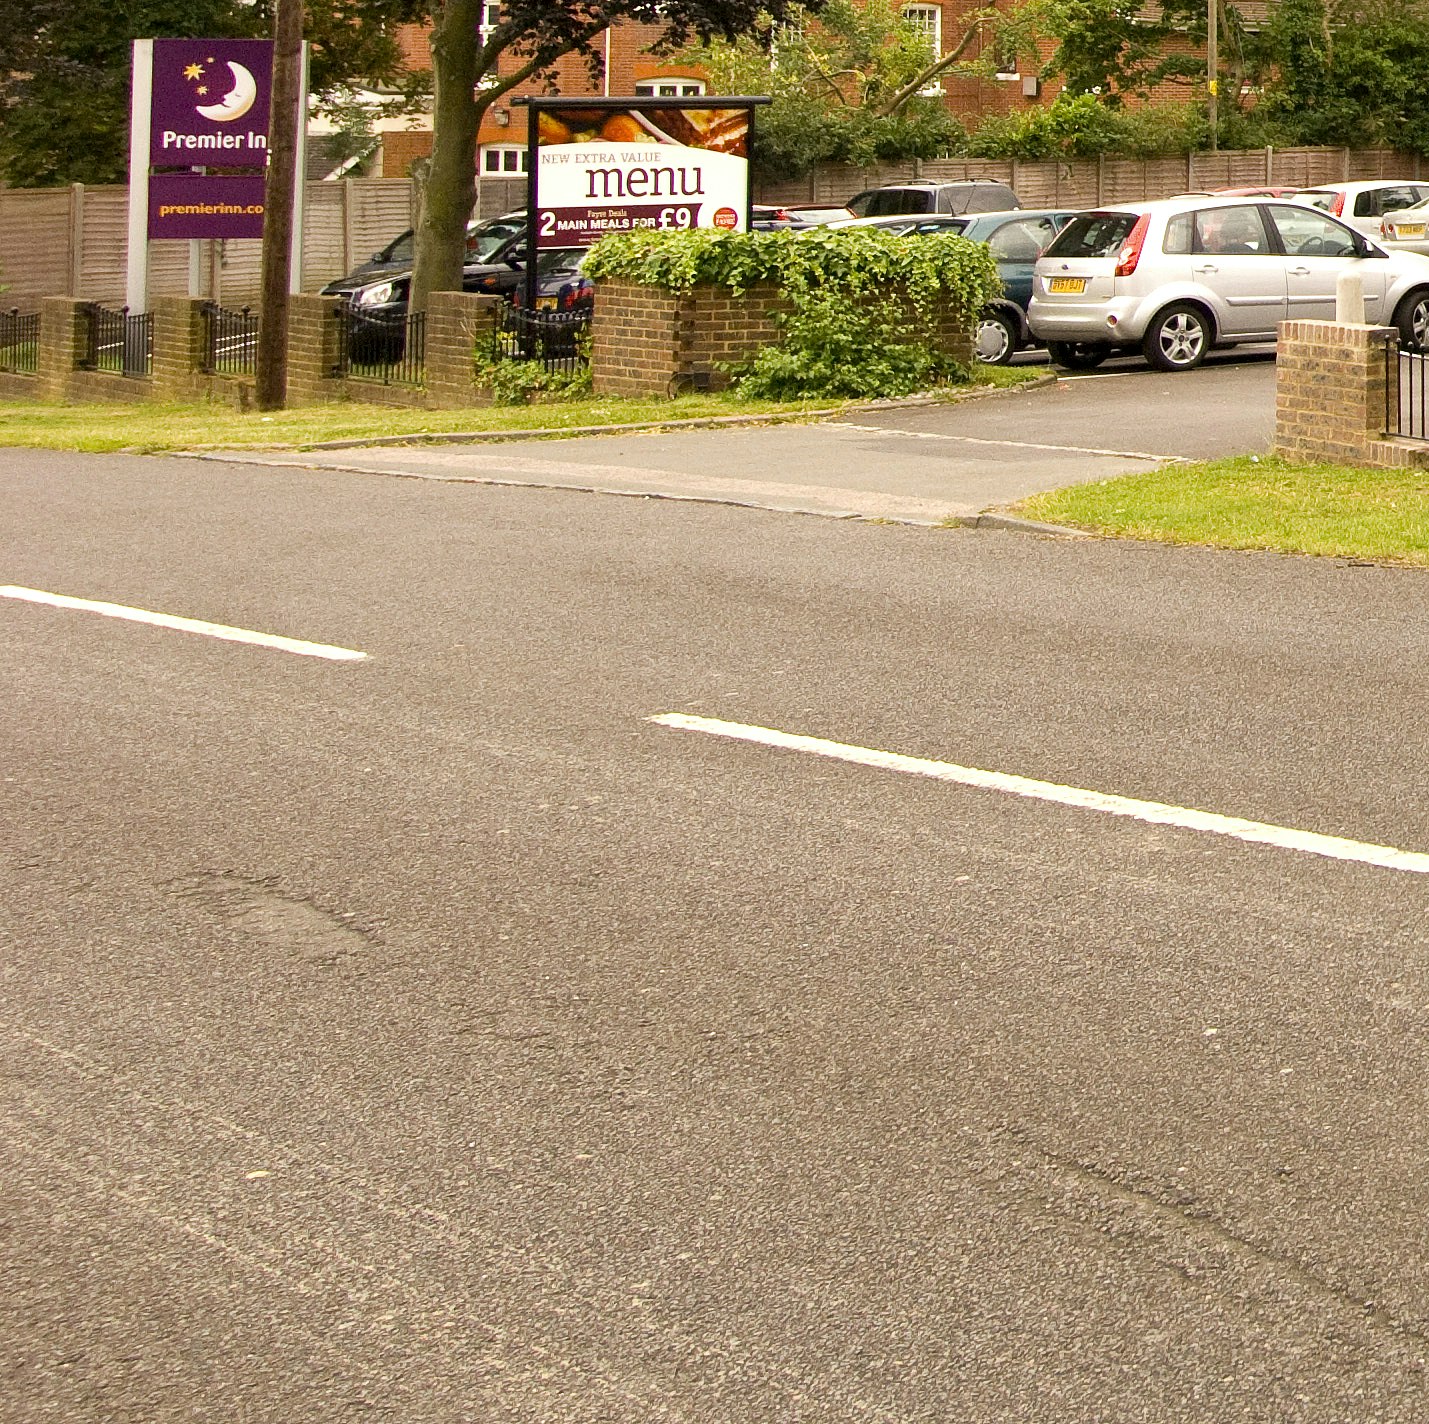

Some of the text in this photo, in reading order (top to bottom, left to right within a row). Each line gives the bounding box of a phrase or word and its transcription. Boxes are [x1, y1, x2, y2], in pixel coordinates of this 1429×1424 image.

[162, 131, 267, 149] Premier In
[541, 152, 662, 164] NEW EXTRA VALUE
[585, 167, 705, 198] menu
[160, 202, 265, 218] premierinn.co
[540, 207, 692, 236] 2 MAIN MEALS FOR £9
